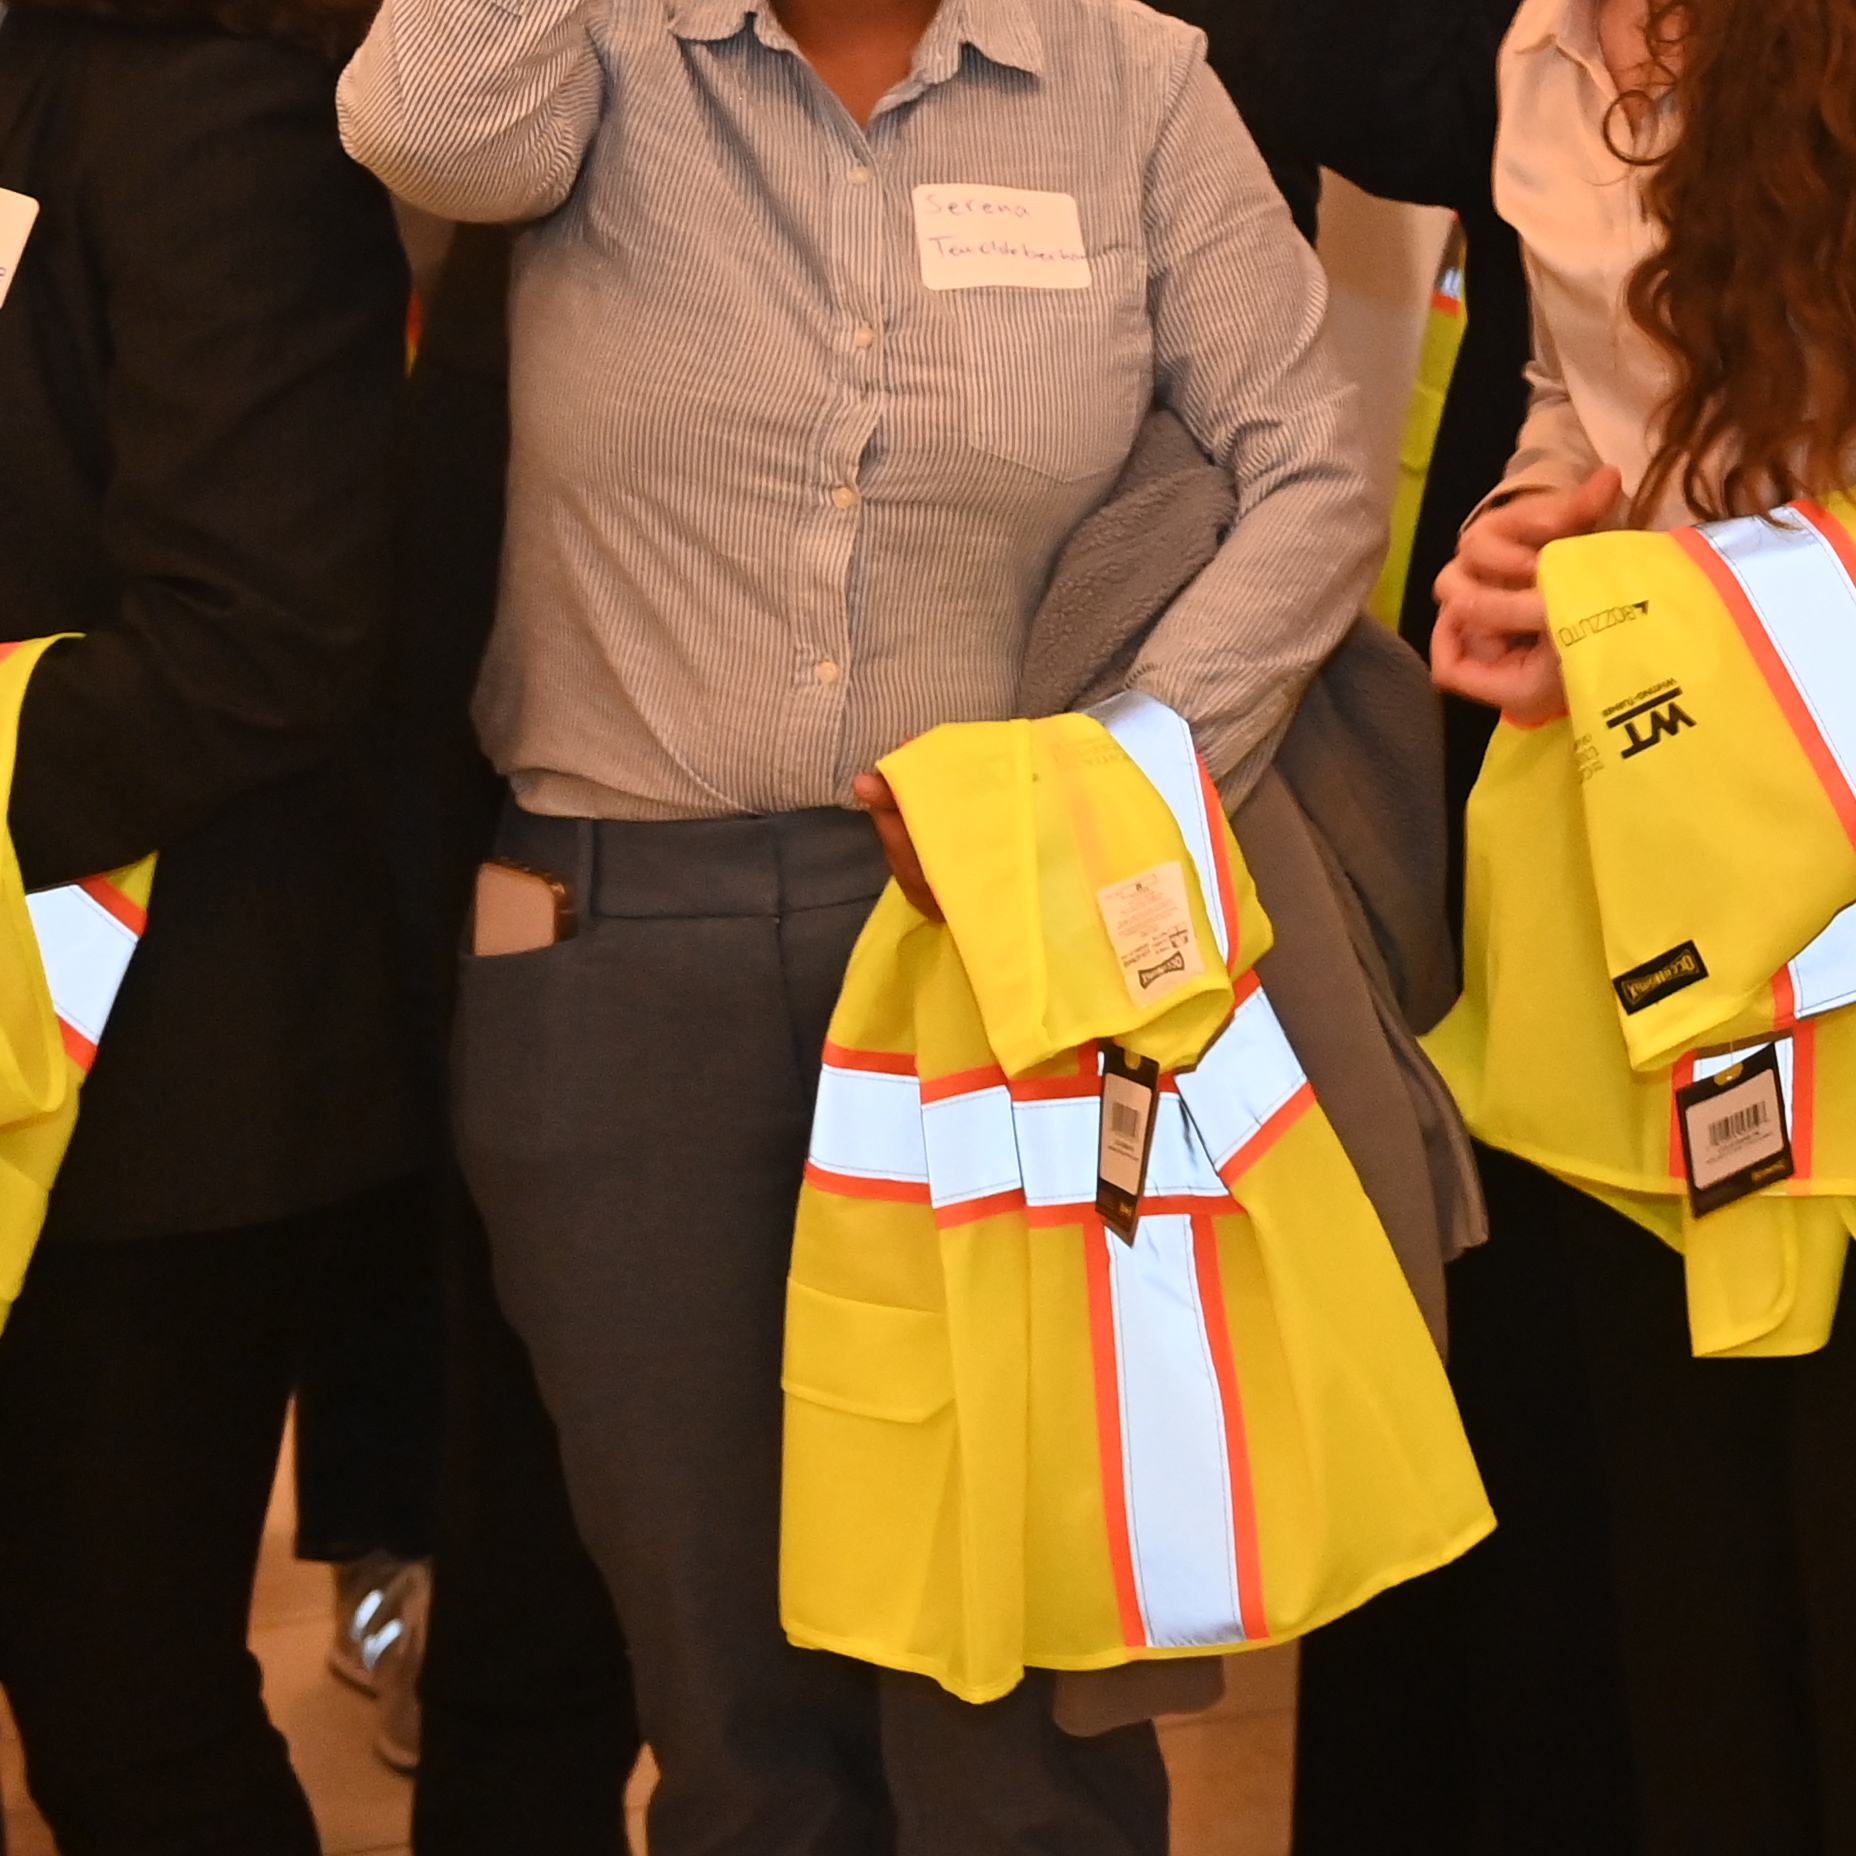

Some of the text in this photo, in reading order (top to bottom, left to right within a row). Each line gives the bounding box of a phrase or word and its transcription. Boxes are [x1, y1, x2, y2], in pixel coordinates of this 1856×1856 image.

[926, 193, 1031, 218] Serena
[1558, 605, 1637, 647] BOZZUTO
[1621, 701, 1697, 760] WT
